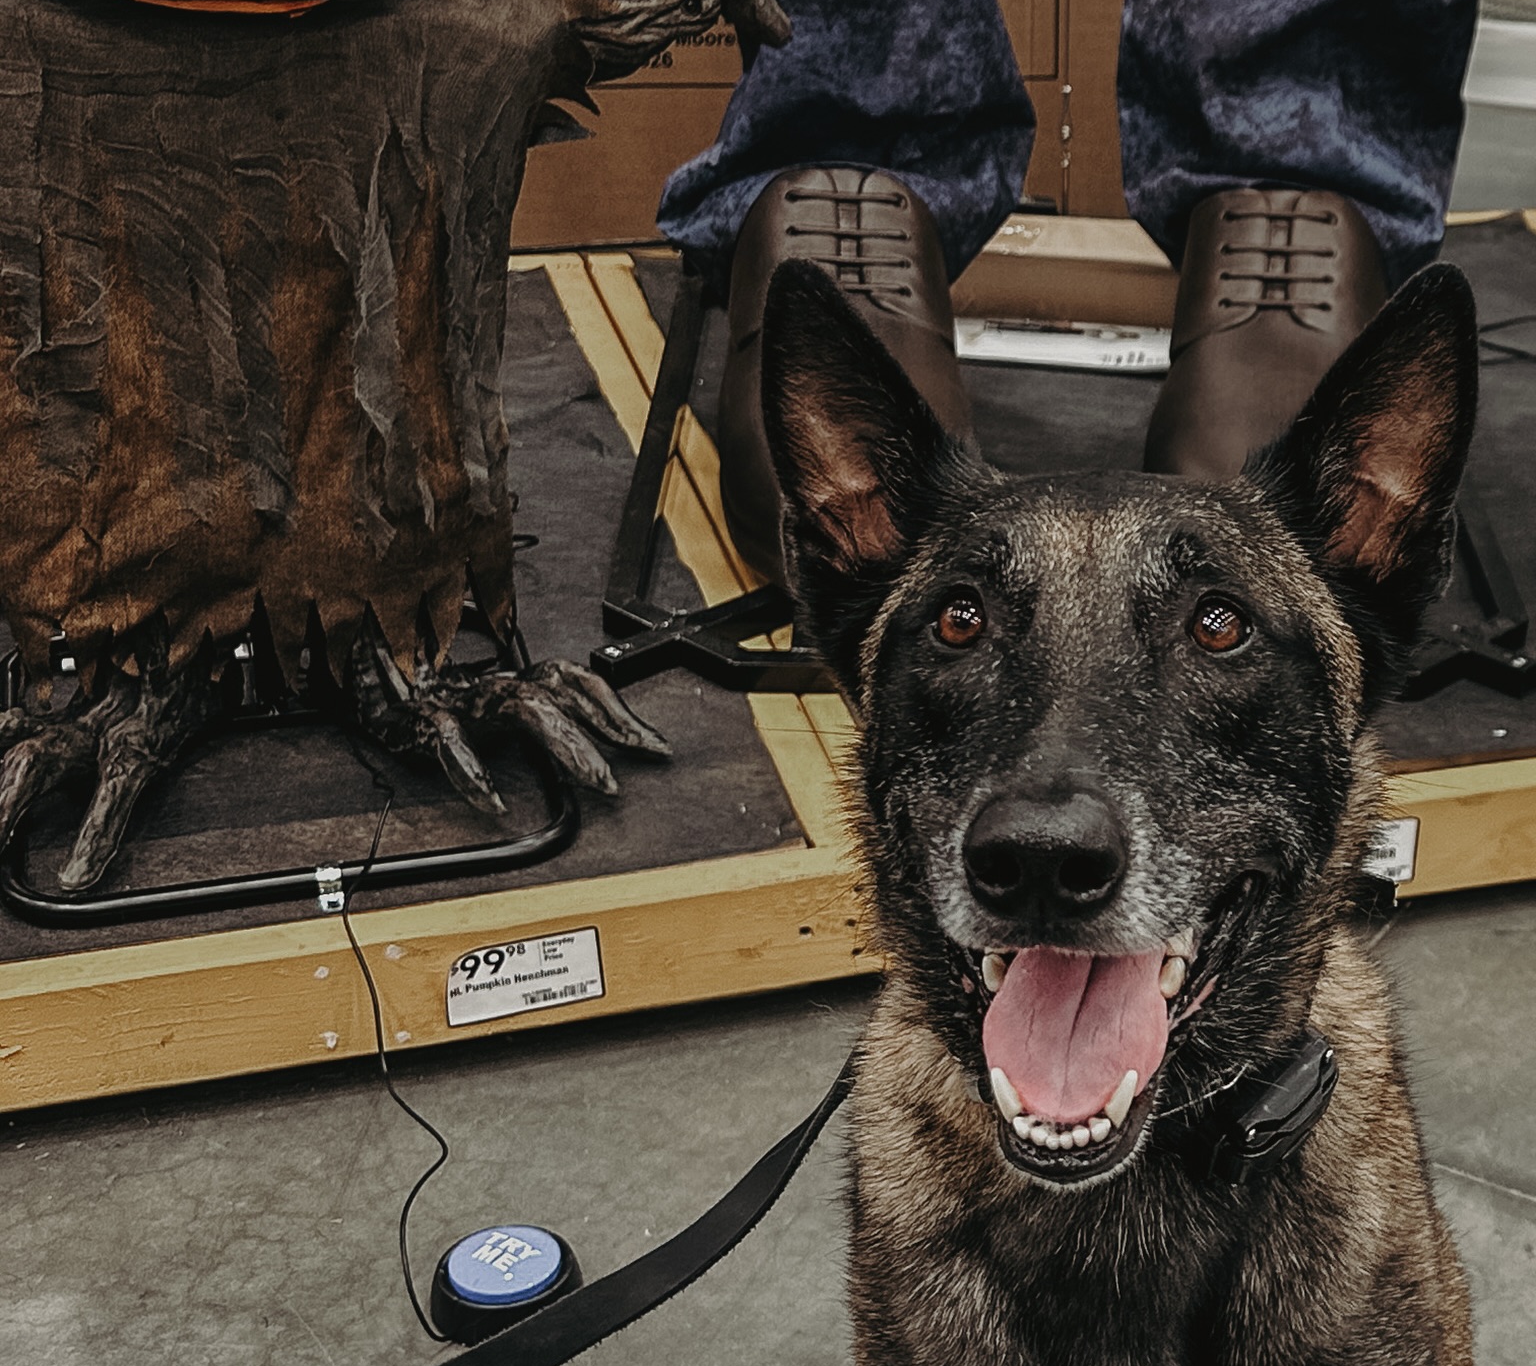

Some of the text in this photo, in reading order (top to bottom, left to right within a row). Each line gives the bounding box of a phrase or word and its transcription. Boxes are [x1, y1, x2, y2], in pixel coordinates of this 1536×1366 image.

[465, 976, 512, 995] Pumpkin
[513, 965, 570, 984] Henchman
[484, 1230, 543, 1261] TRY
